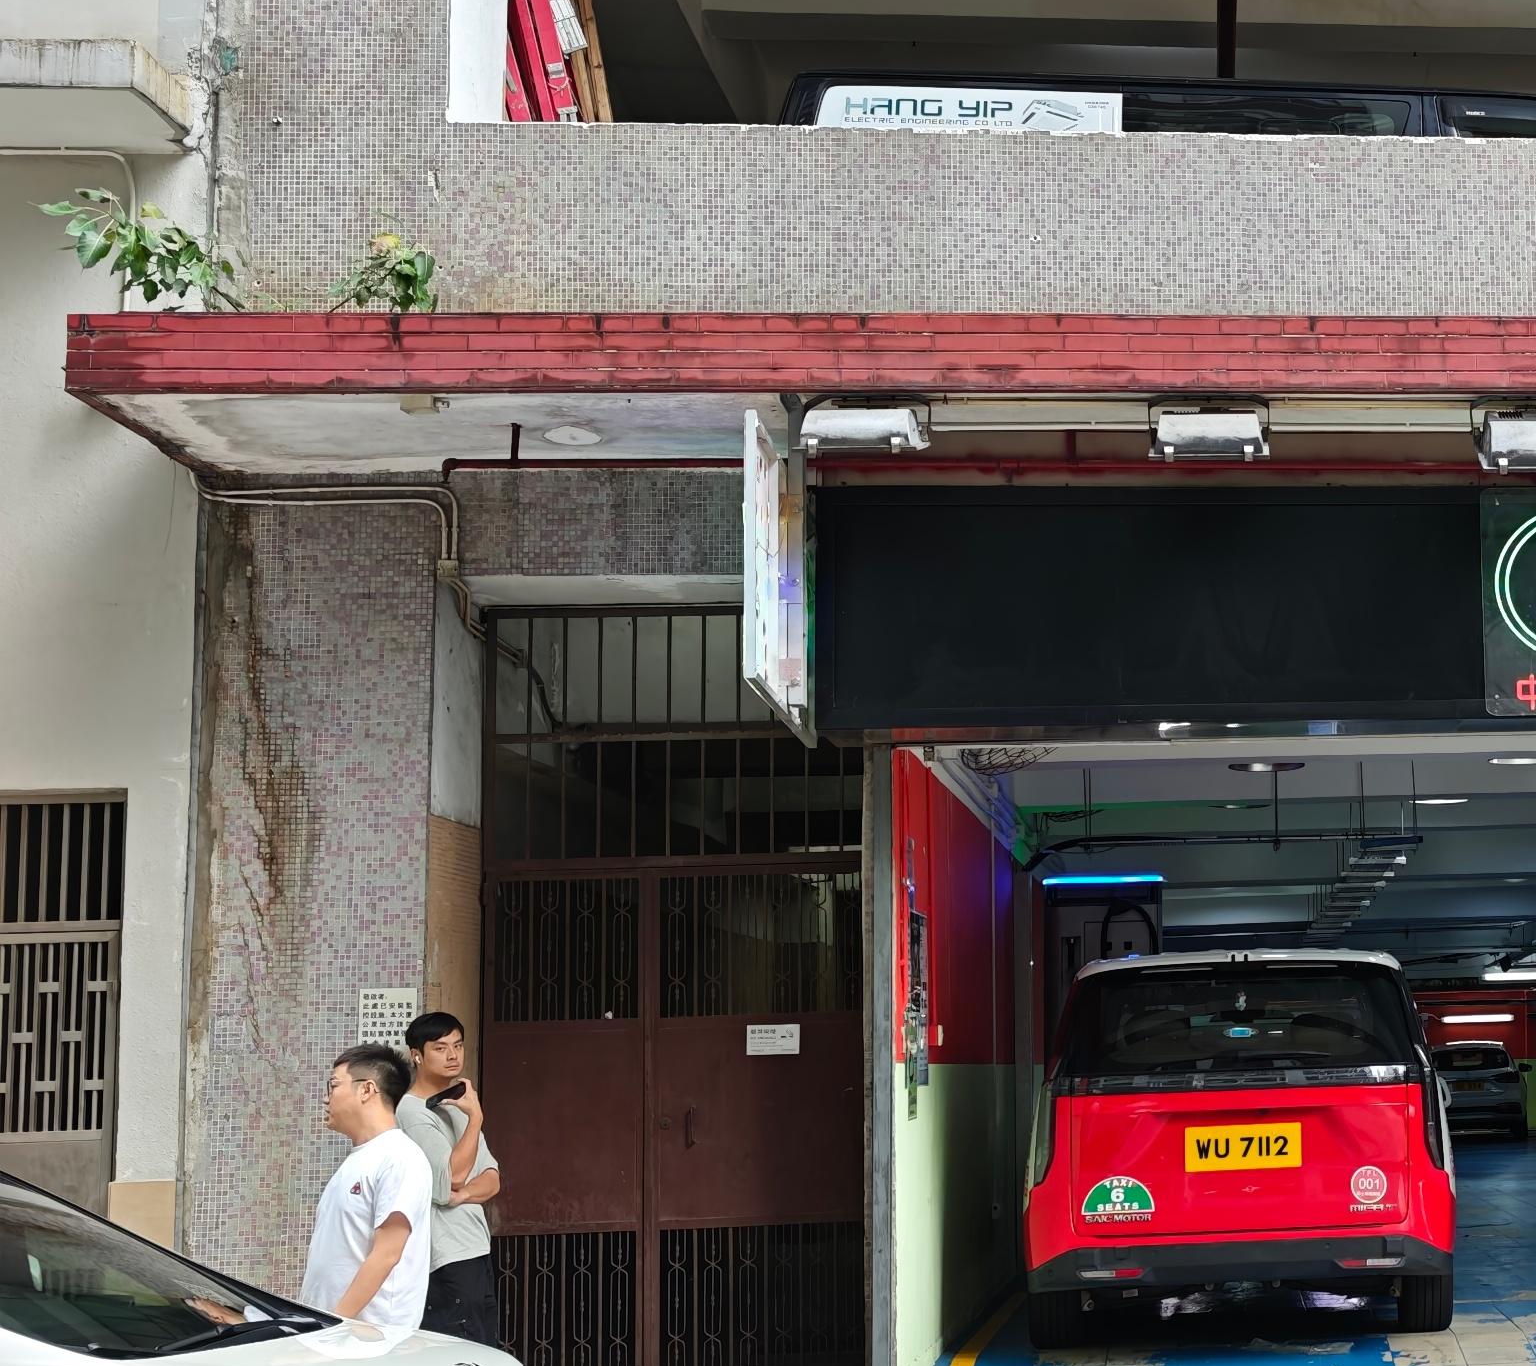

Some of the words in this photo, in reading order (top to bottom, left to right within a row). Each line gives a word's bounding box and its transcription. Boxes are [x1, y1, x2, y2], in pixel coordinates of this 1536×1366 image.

[845, 97, 943, 117] HANG
[958, 100, 1013, 118] YIP
[901, 118, 969, 126] ENGINEERING
[1196, 1138, 1229, 1159] WU
[1241, 1136, 1288, 1157] 7112
[1104, 1179, 1133, 1188] TAXI
[1359, 1178, 1379, 1190] 001
[1111, 1188, 1124, 1202] 6
[1097, 1202, 1139, 1211] SEATS
